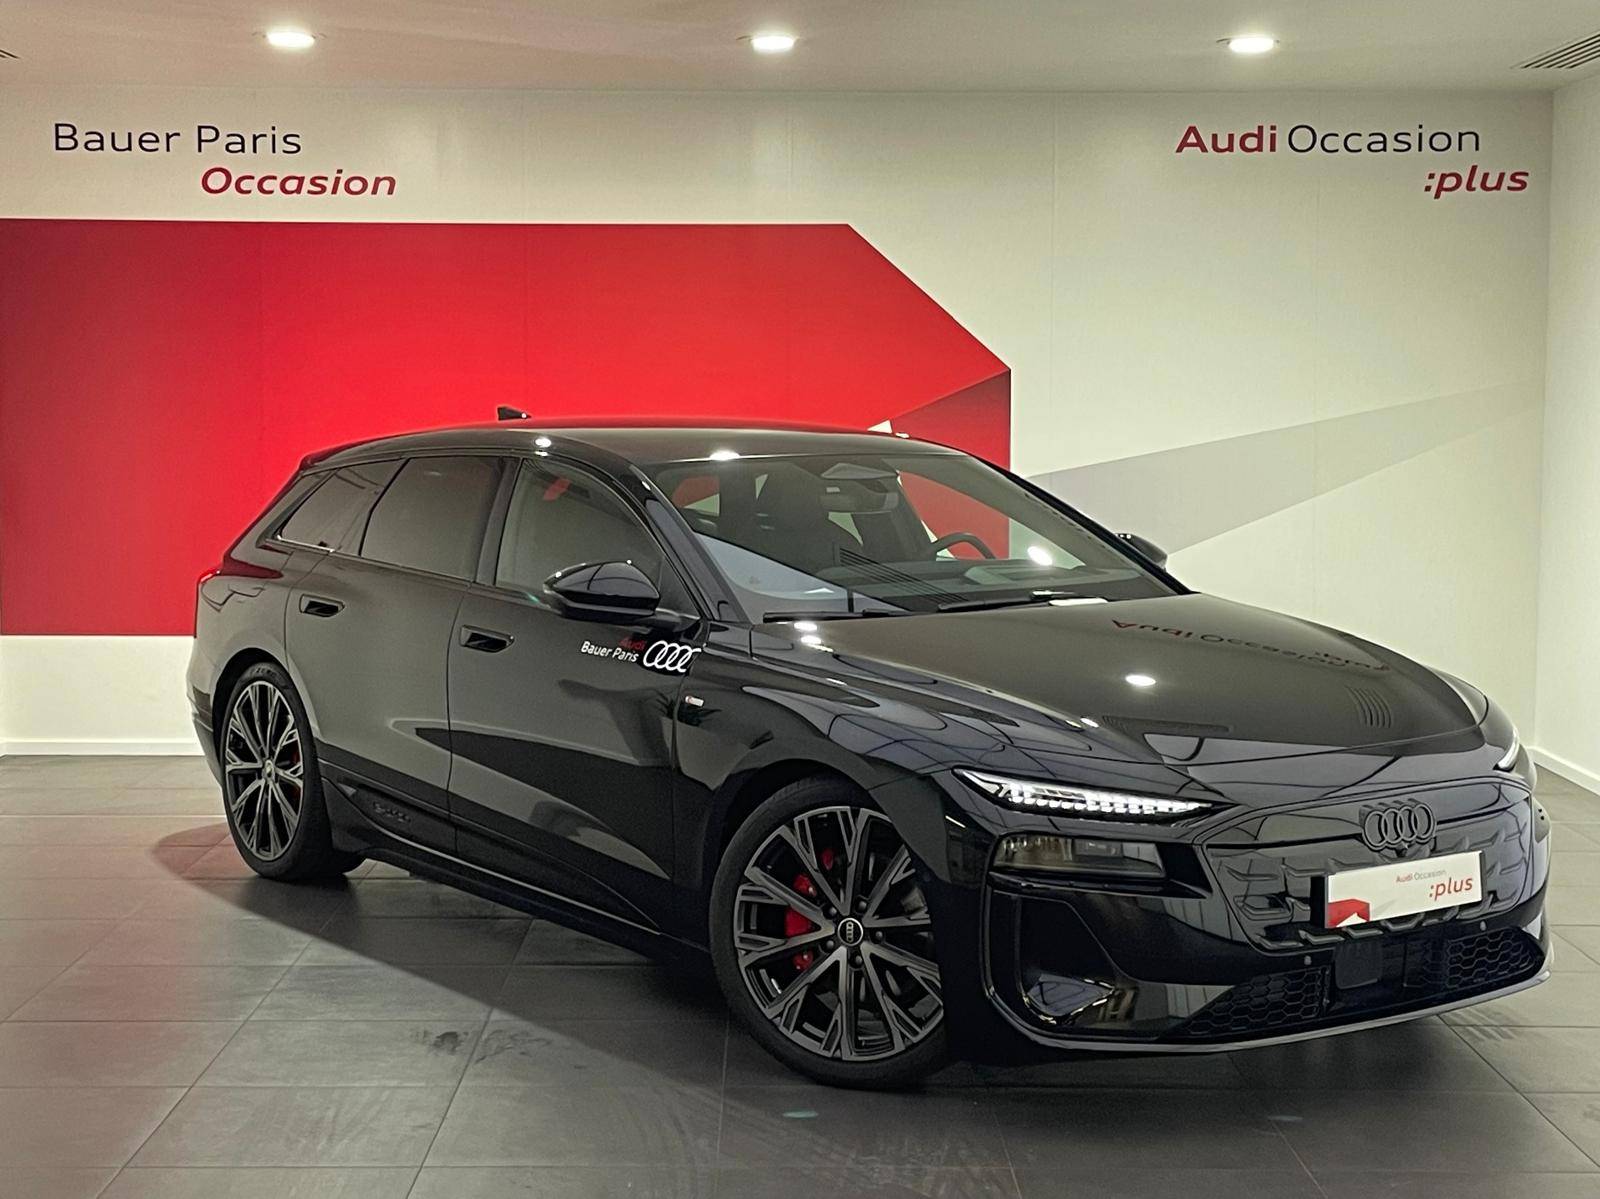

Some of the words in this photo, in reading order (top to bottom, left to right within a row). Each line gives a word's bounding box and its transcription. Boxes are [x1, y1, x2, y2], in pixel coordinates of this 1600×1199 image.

[53, 123, 180, 153] Bauer
[196, 125, 302, 155] Paris
[1175, 125, 1278, 154] Audi
[1287, 124, 1481, 153] Occasion
[200, 167, 397, 196] Occasion
[1423, 165, 1530, 199] :plus
[581, 640, 612, 658] Bauer
[612, 647, 640, 663] Paris
[1395, 872, 1413, 883] Audi
[1413, 869, 1447, 881] Occasion
[1428, 876, 1473, 901] :plus
